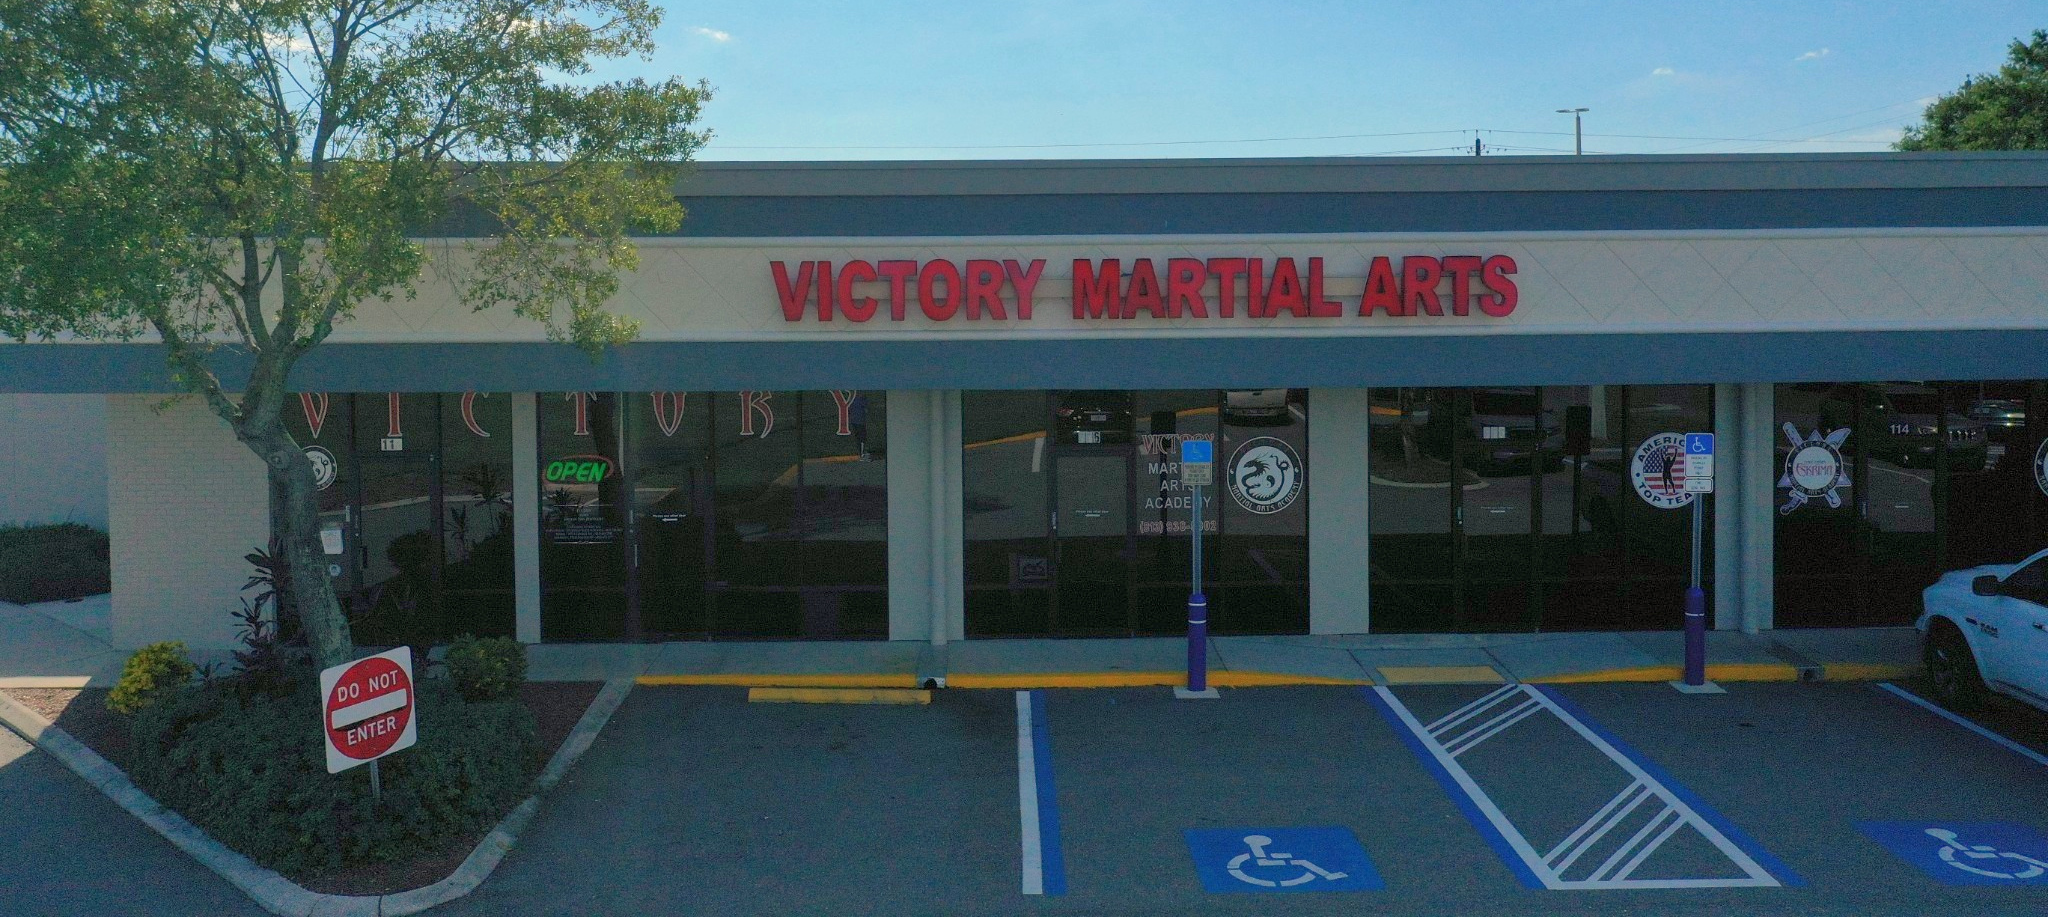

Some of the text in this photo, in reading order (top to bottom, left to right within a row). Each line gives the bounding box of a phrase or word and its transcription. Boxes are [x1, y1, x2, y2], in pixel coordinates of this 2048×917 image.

[770, 254, 1518, 323] VICTORY MARTIAL ARTS
[1890, 424, 1910, 435] 114
[1637, 436, 1686, 463] AMERIC
[546, 461, 608, 483] OPEN
[1145, 496, 1212, 509] ACADEY
[1638, 482, 1693, 505] TOP TEA
[1256, 504, 1275, 512] ARTS
[337, 669, 399, 702] DO NOT
[347, 715, 397, 746] ENTER
